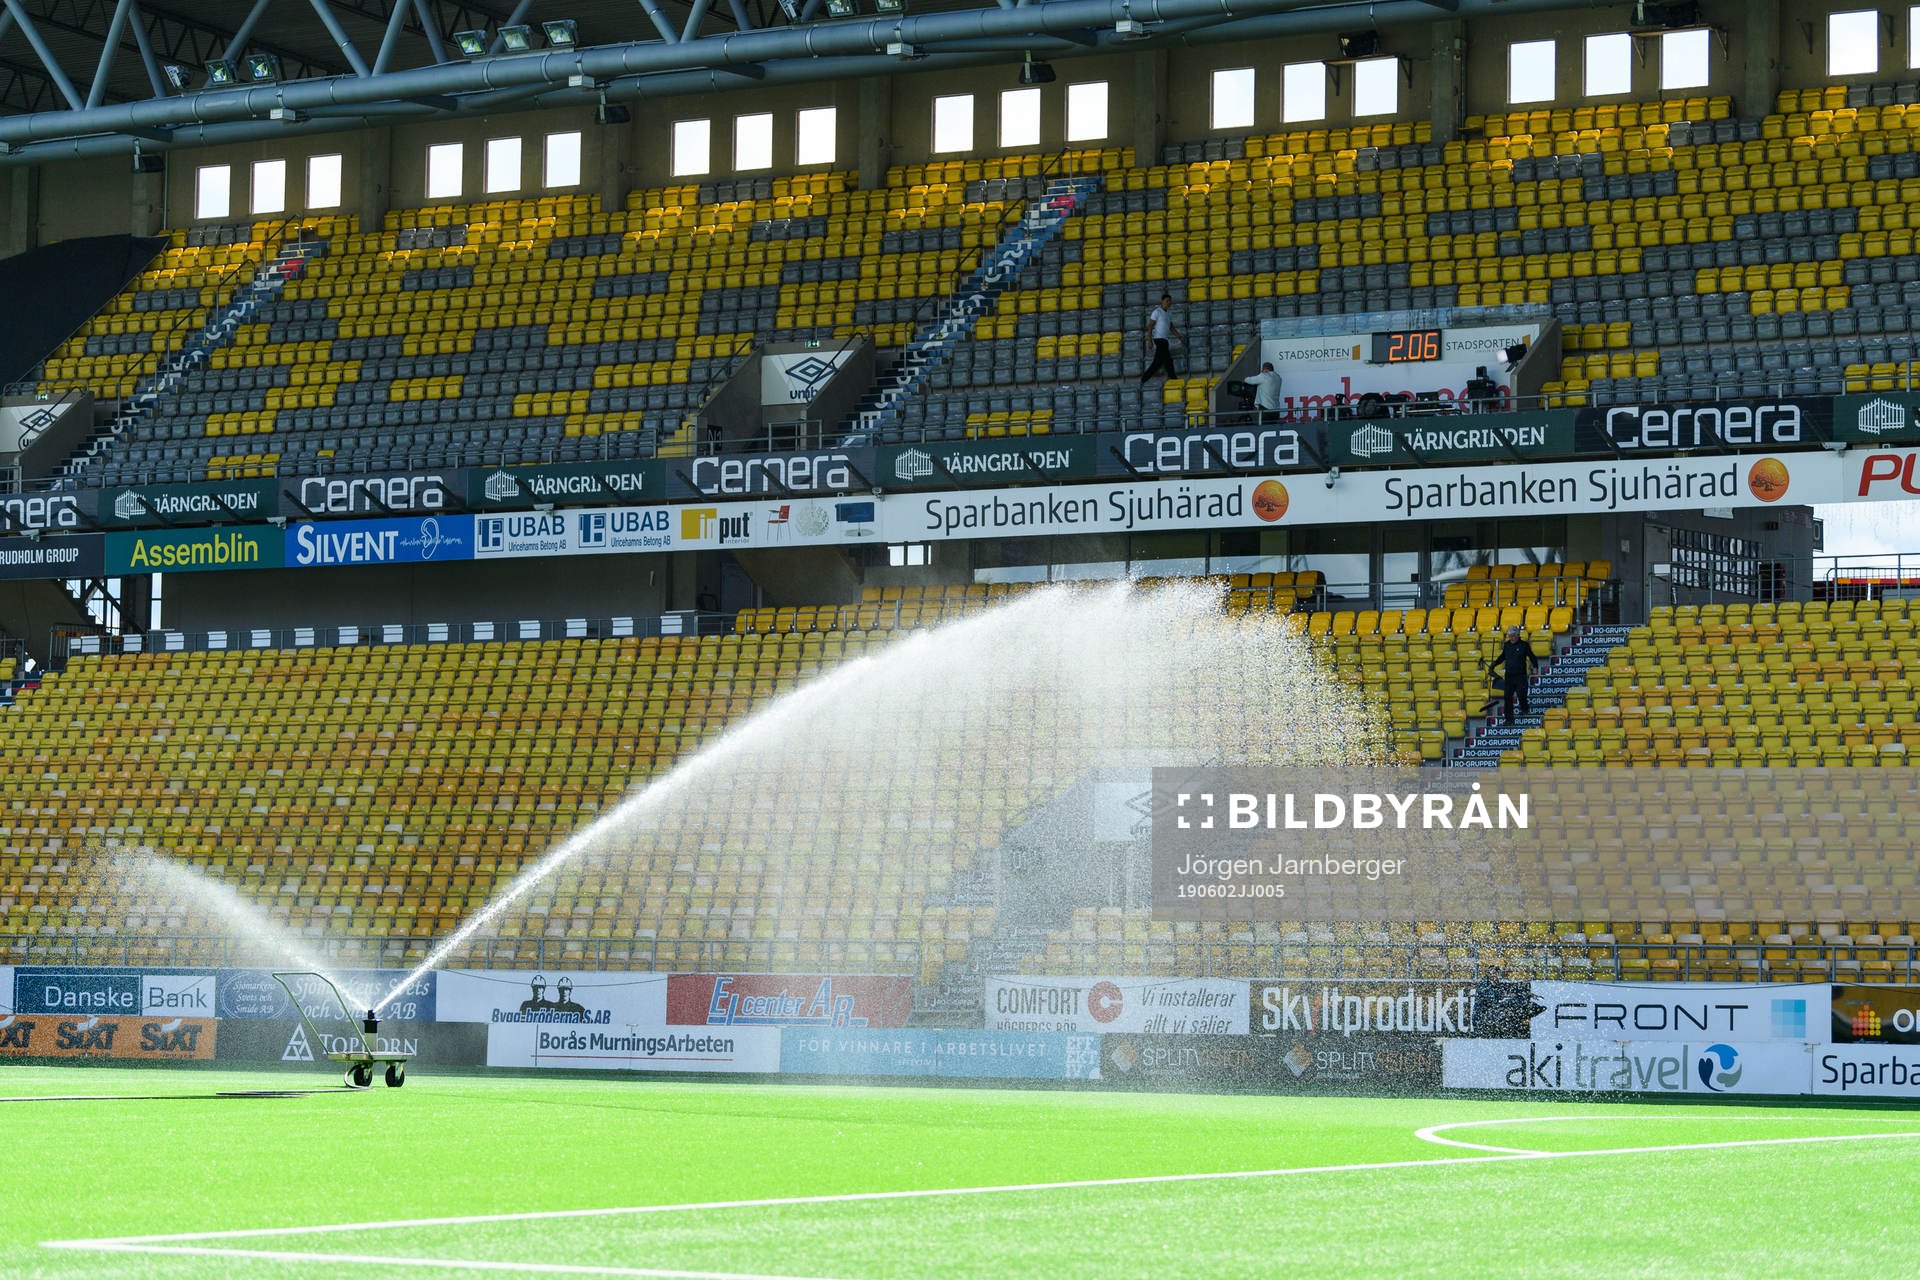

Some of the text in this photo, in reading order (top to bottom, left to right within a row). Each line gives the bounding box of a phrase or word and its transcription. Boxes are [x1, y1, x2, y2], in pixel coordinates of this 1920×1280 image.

[1278, 347, 1350, 361] STADSPORTEN
[1388, 332, 1439, 362] 2.06
[1446, 337, 1520, 351] STADSPORTEN
[1606, 404, 1801, 448] Cernera
[1124, 430, 1299, 473] Cernera
[692, 454, 849, 494] Cernera
[301, 475, 443, 513] Cernera
[1385, 462, 1737, 516] Sparbanken Sjuhärad
[0, 495, 77, 530] nera
[611, 510, 670, 532] UBAB
[926, 484, 1242, 536] Sparbanken Sjuhärad
[508, 515, 565, 537] UBAB
[130, 533, 258, 567] Assemblin
[296, 524, 399, 565] SILVENT
[540, 540, 558, 552] Betong
[559, 540, 567, 549] AB
[641, 536, 662, 547] Betong
[663, 535, 671, 545] AB
[46, 547, 79, 563] GROUP
[1553, 667, 1589, 675] RO-GRUPPE
[1562, 657, 1604, 665] RO-GRUPPEN
[1531, 687, 1568, 695] RO-GRUPPE
[1488, 728, 1525, 736] RO-GRUPPE
[1465, 749, 1502, 757] RO-GRUPP
[45, 986, 207, 1008] Danske Bank
[741, 989, 807, 1016] center
[997, 987, 1082, 1016] COMFORT
[1142, 986, 1236, 1008] Vi installerar
[386, 1002, 417, 1020] AB
[1555, 1003, 1748, 1031] FRONT
[1143, 1014, 1169, 1033] allt
[1174, 1016, 1188, 1033] vi
[539, 1030, 734, 1056] Borås MurningsArbeten
[839, 1040, 912, 1054] VINNARE
[934, 1042, 1046, 1057] ARBETSLIVET
